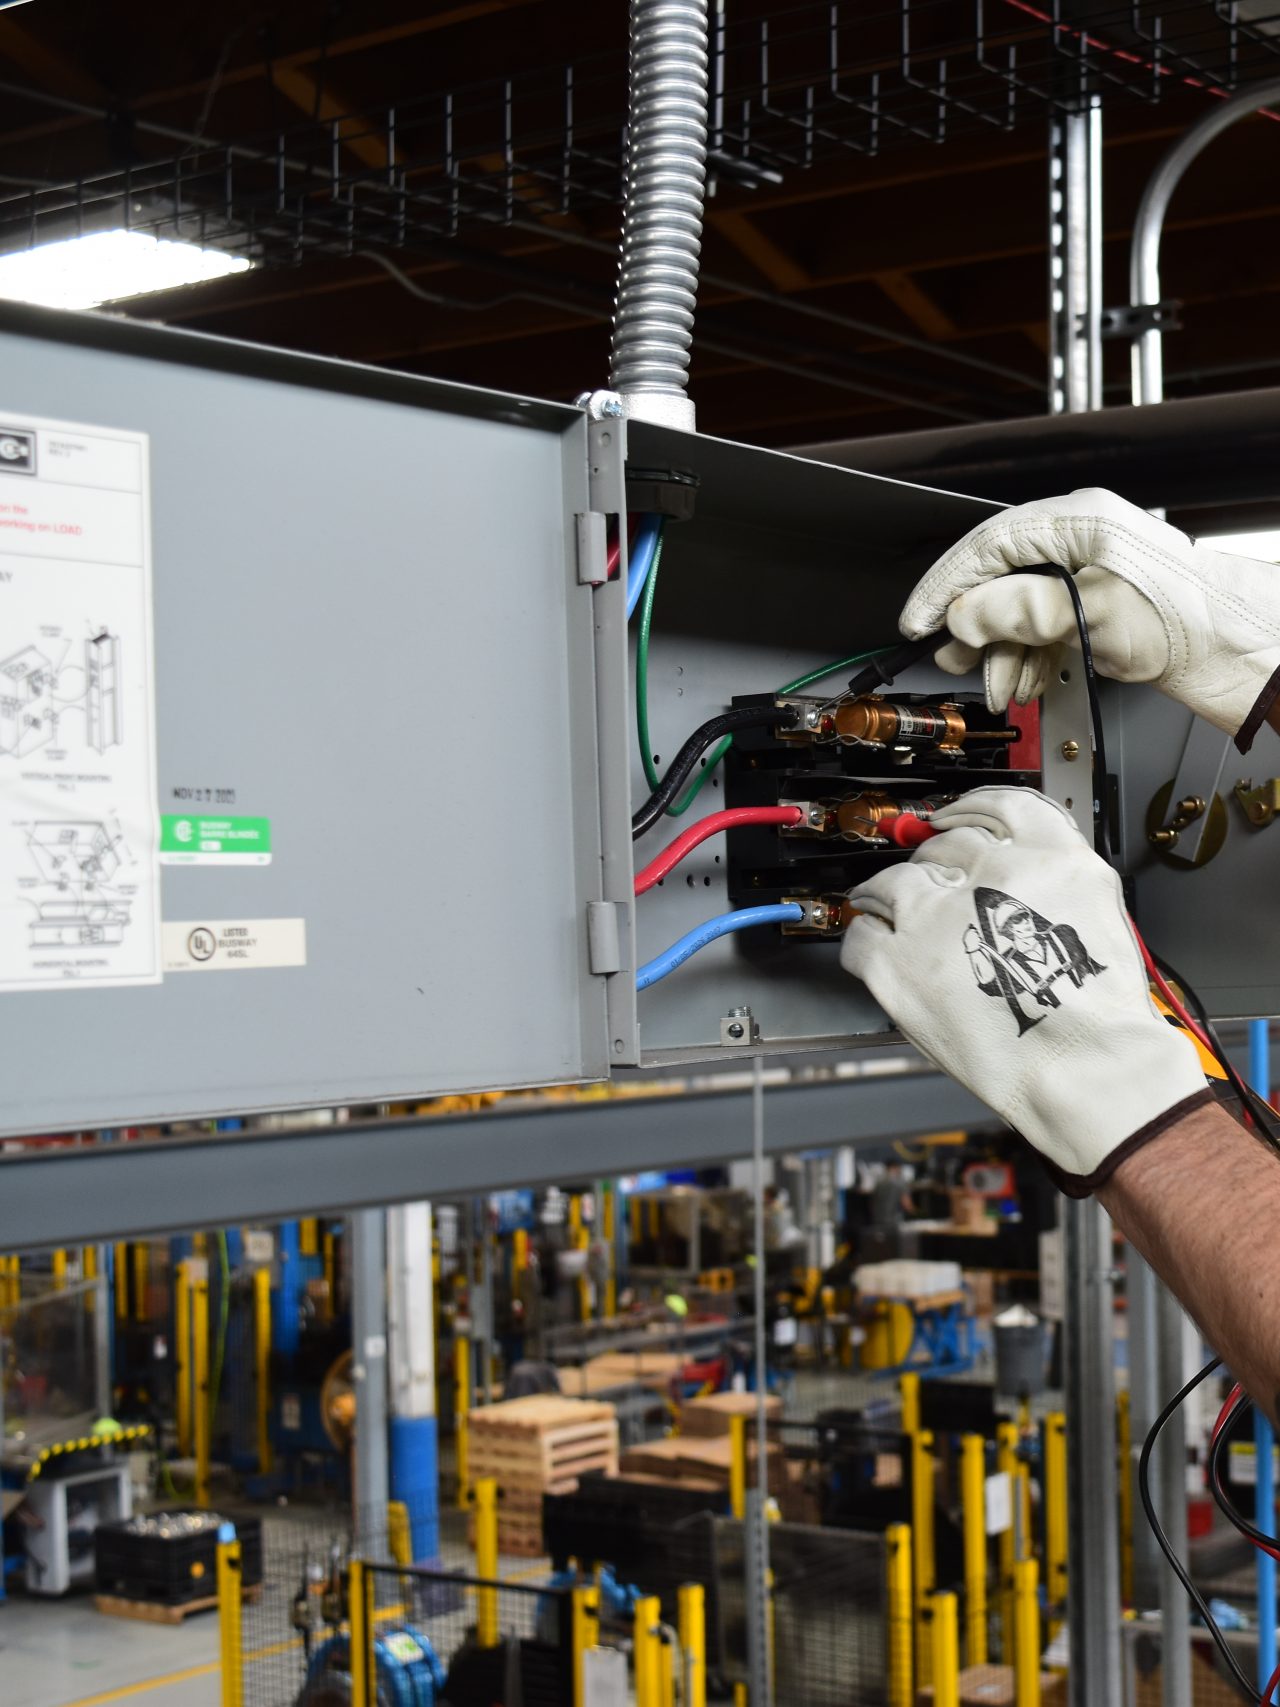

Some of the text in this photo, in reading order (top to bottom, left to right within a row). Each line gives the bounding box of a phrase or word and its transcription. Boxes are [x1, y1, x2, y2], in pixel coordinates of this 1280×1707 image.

[13, 504, 28, 514] the
[38, 523, 51, 532] on
[53, 523, 82, 536] LOAD
[173, 787, 193, 800] NOV
[218, 938, 258, 949] BUSWAY
